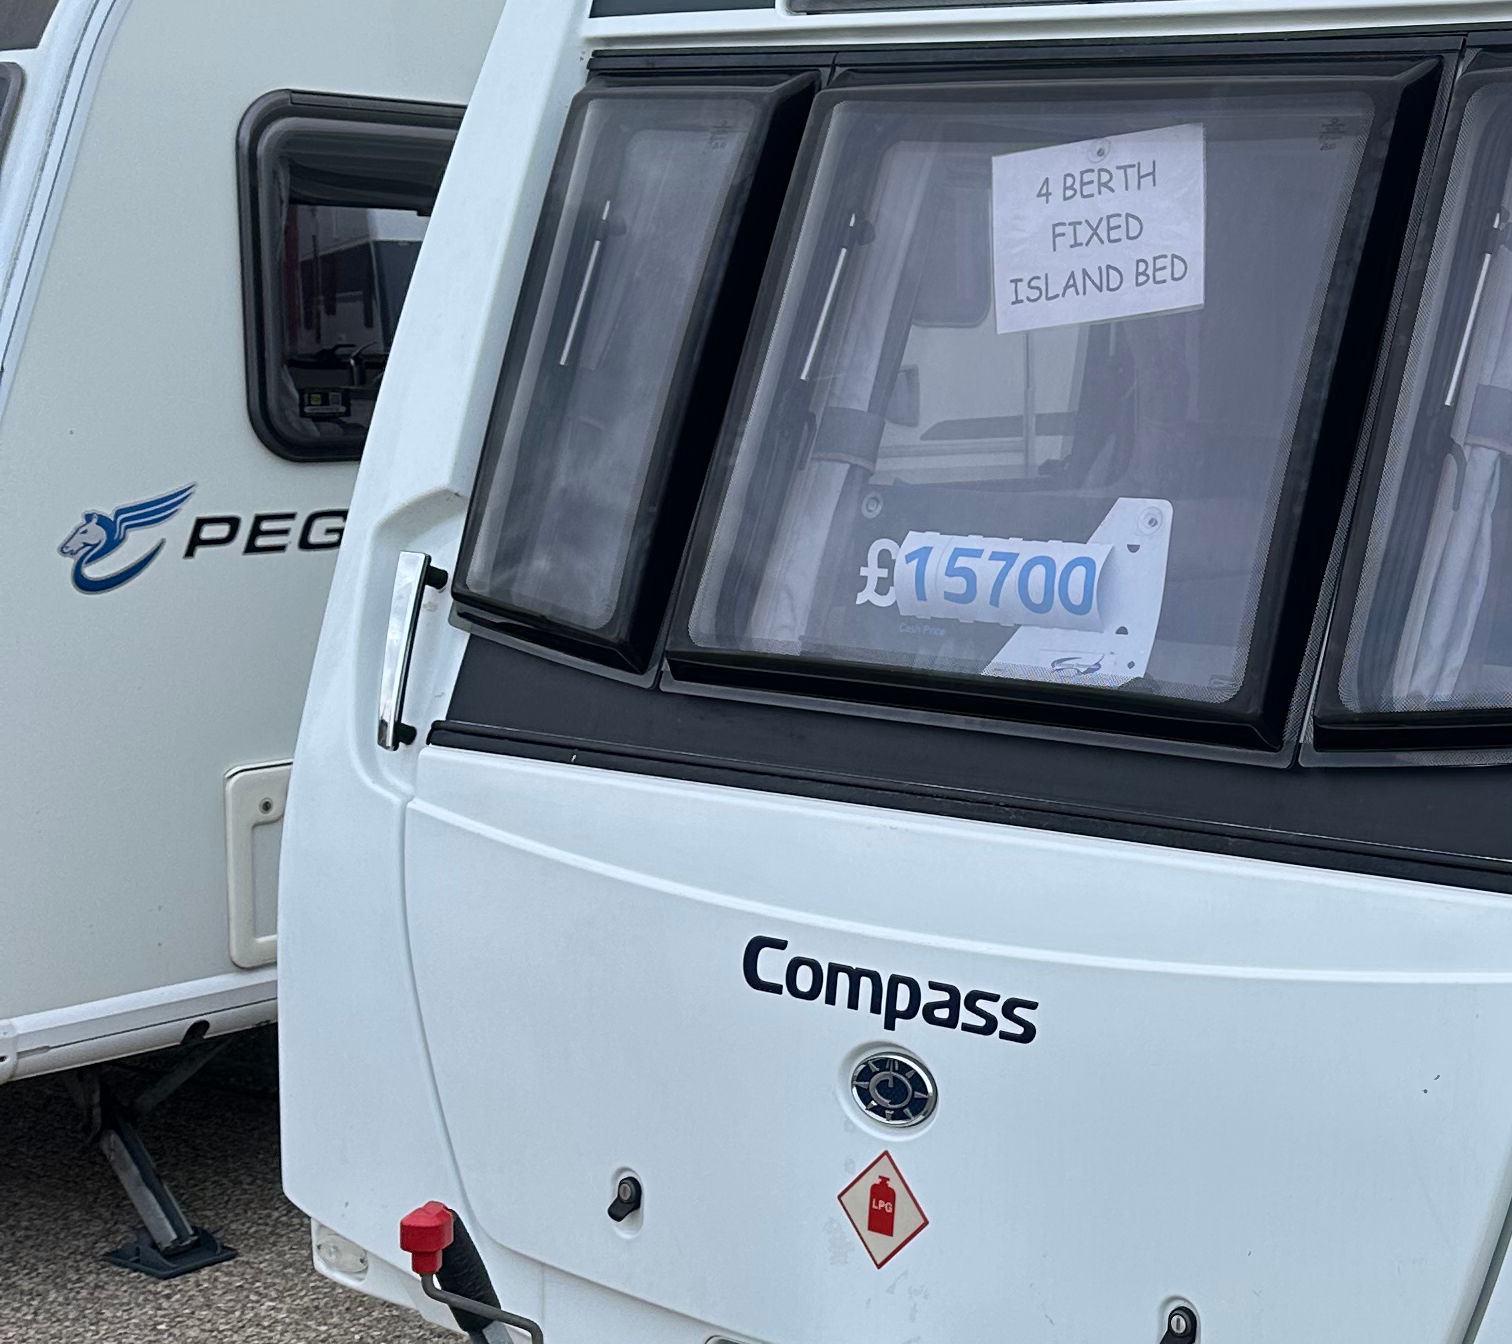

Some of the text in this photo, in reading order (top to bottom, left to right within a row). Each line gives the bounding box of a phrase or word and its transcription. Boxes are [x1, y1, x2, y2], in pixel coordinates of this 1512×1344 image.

[1036, 160, 1156, 204] 4 BERTH
[1051, 212, 1143, 252] FIXED
[1010, 253, 1188, 305] ISLAND BED
[855, 538, 1097, 616] £15700
[743, 935, 1039, 1044] Compass
[872, 1198, 893, 1213] LPG
